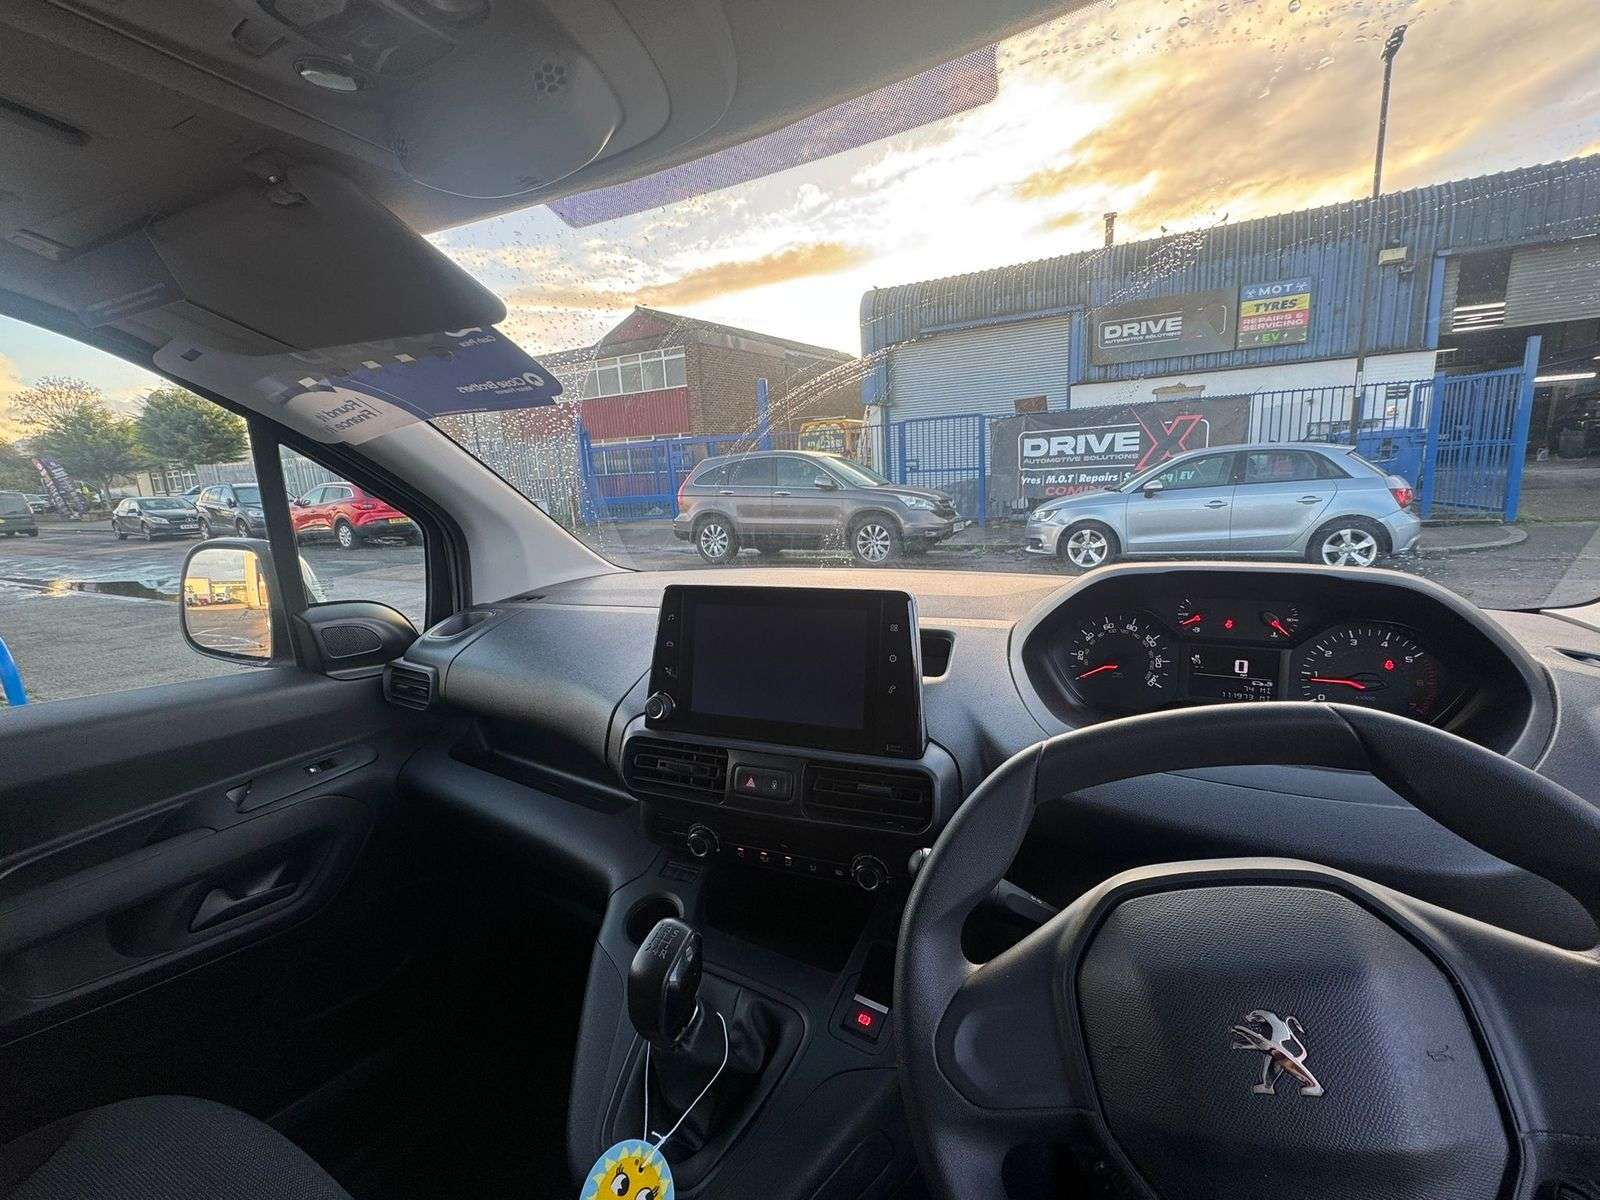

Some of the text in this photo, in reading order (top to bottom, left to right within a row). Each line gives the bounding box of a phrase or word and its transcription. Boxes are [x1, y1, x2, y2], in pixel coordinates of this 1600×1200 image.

[1258, 283, 1293, 296] MOT
[1254, 299, 1297, 312] TYRES
[1242, 313, 1292, 326] REPAIRS
[1242, 319, 1304, 331] SERVICING
[1104, 316, 1183, 339] DRIVE
[1262, 332, 1281, 342] EV
[1023, 431, 1141, 457] DRIVE
[1023, 452, 1139, 465] AUTOMOTIVE SOLUTIONS
[1021, 475, 1041, 486] yres
[1045, 473, 1074, 484] M.O.T
[1078, 471, 1118, 484] Repairs
[1180, 470, 1195, 480] EV
[1103, 623, 1115, 631] 60
[1126, 623, 1138, 632] 80
[1350, 638, 1358, 646] 3
[1380, 641, 1388, 649] 4
[1077, 650, 1085, 661] 20
[1324, 650, 1333, 658] 2
[1234, 659, 1249, 674] 0
[1243, 685, 1255, 693] 74
